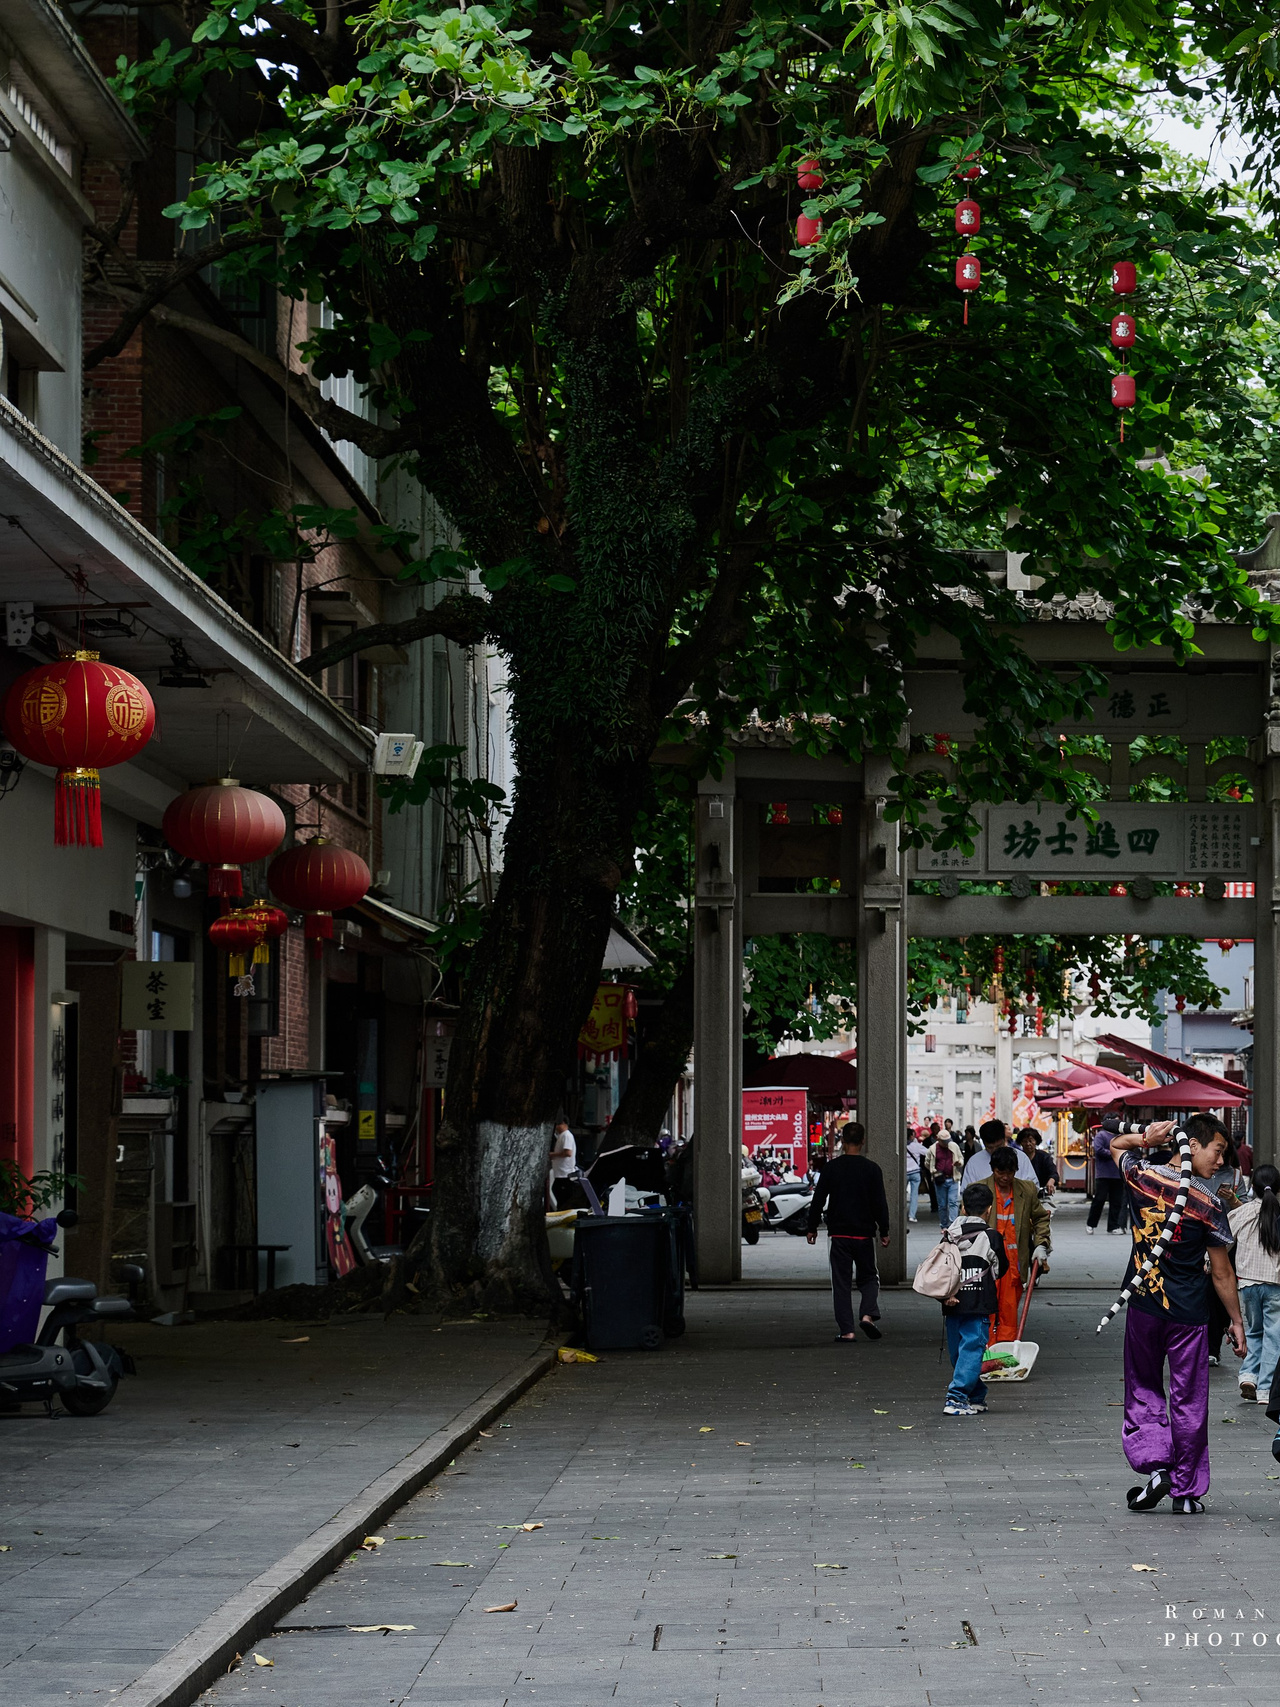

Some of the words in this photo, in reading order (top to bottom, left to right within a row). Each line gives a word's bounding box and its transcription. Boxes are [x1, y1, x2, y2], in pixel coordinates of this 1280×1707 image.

[23, 686, 60, 725] 福
[114, 691, 144, 729] 福
[1083, 689, 1172, 718] 正德
[145, 970, 168, 1020] 茶室
[793, 1110, 802, 1148] Photo.
